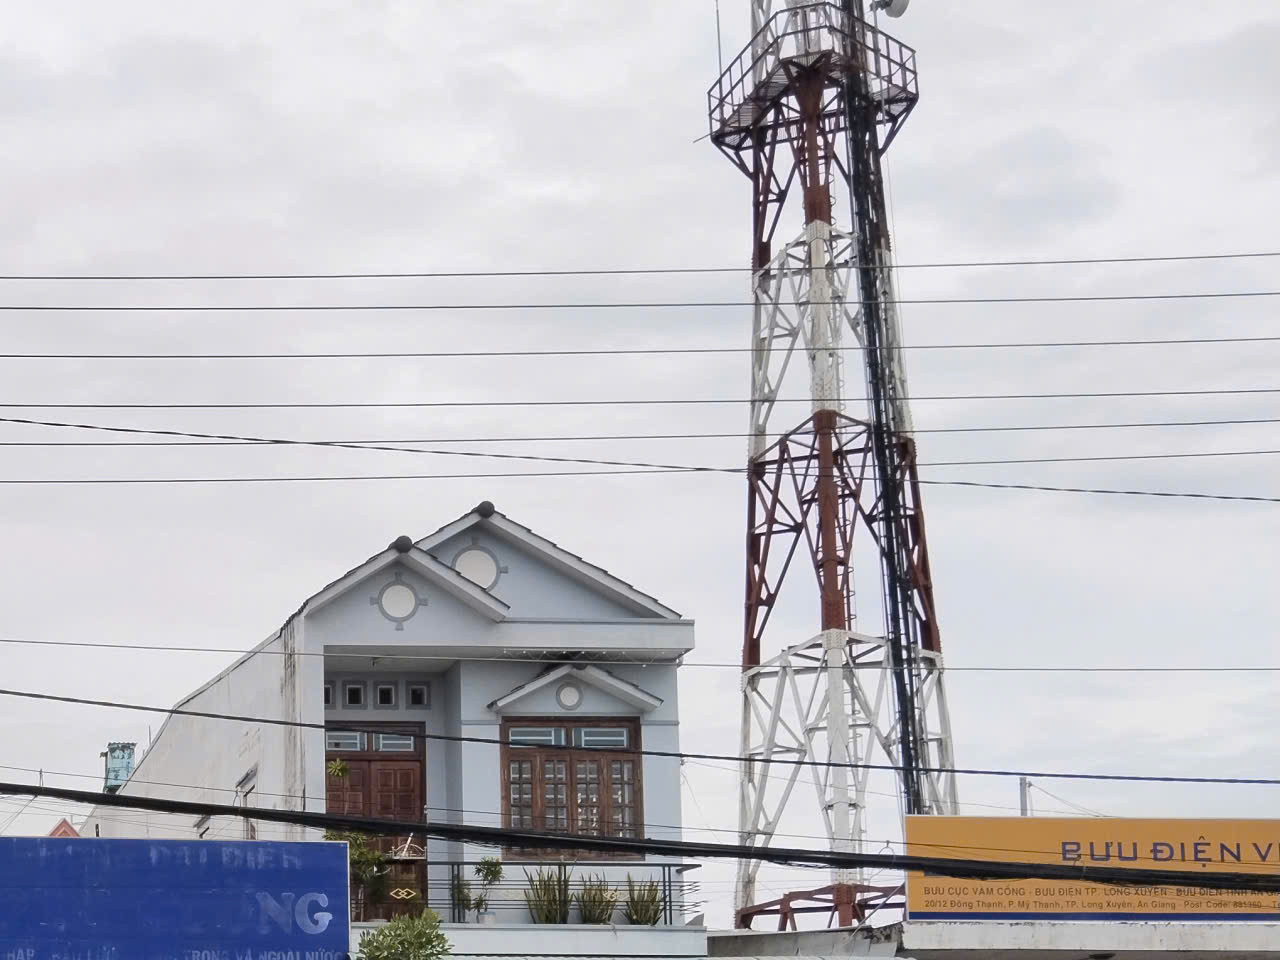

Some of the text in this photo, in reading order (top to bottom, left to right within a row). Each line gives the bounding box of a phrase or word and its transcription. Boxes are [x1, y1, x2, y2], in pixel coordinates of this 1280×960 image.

[1061, 841, 1139, 862] BƯU
[1149, 836, 1241, 868] ĐIỆN
[924, 900, 948, 909] 20/12
[1081, 900, 1104, 910] Long
[1151, 900, 1176, 911] Giang
[1184, 900, 1203, 909] Post
